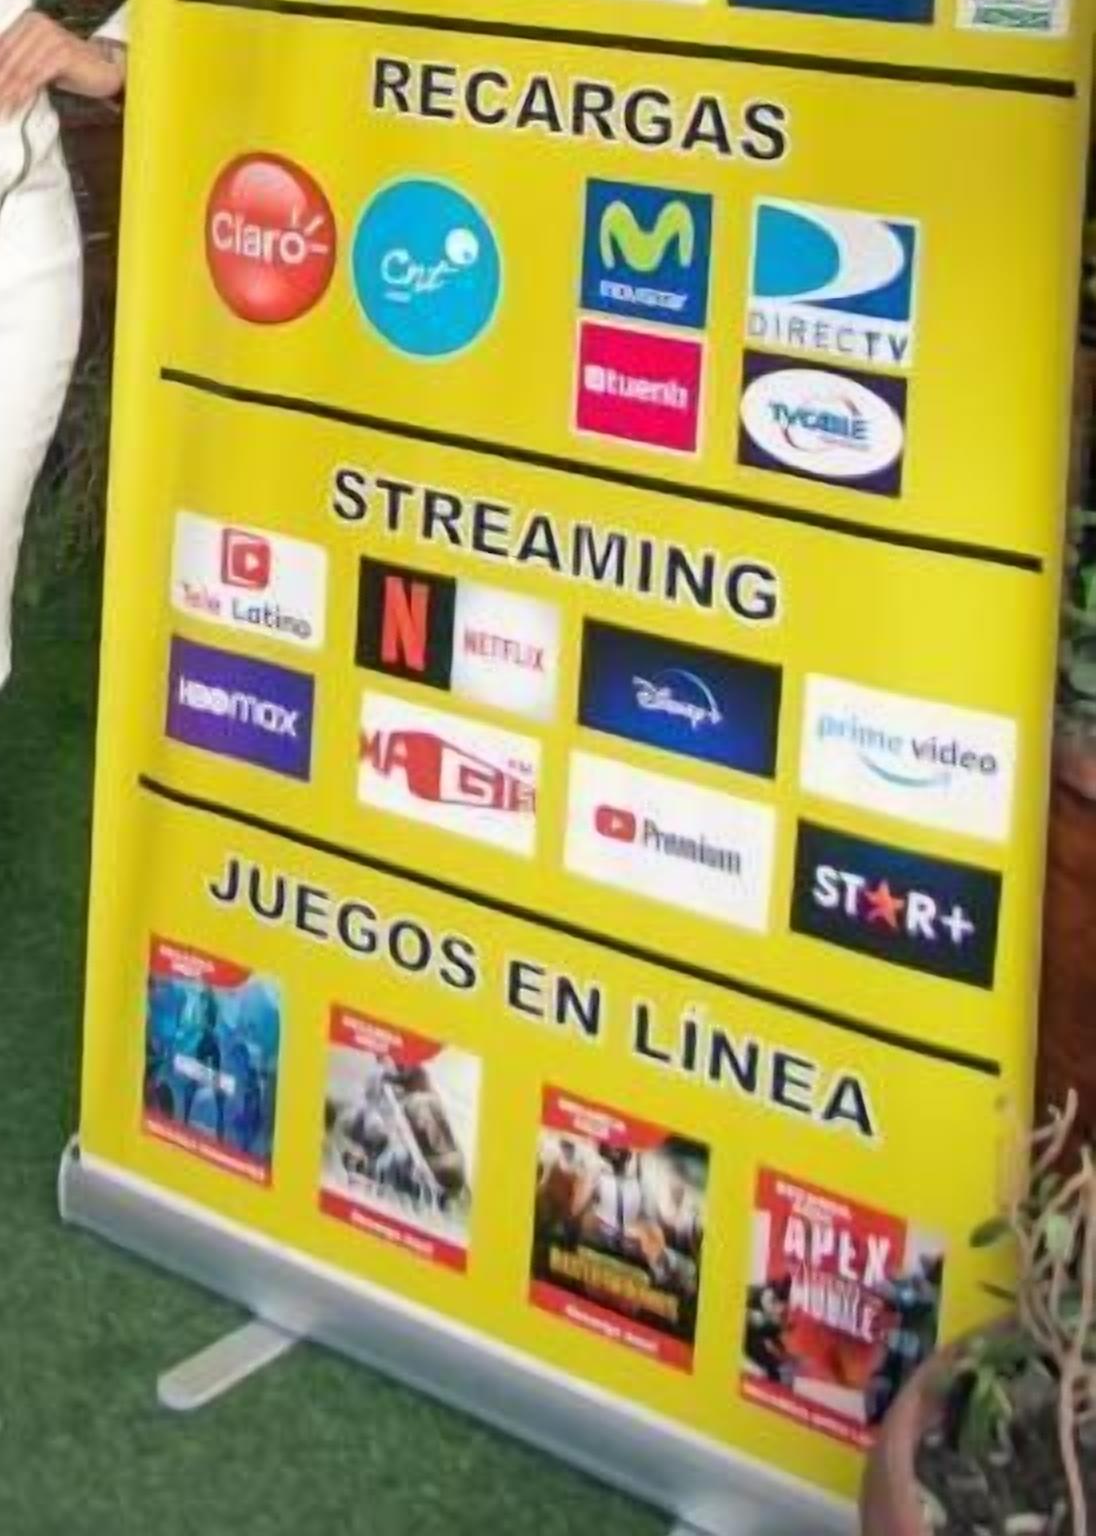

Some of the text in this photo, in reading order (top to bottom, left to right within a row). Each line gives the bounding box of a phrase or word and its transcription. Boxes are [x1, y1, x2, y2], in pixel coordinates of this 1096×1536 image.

[373, 57, 786, 160] RECARGAS
[211, 211, 306, 265] Claro
[748, 309, 908, 362] DIRECTV
[333, 470, 778, 621] STREAMING
[232, 597, 312, 641] Latino
[463, 627, 545, 674] NETFLIX
[817, 710, 998, 776] prime video
[643, 818, 741, 875] Premium
[209, 859, 874, 1137] JUEGOS EN LÍNEA
[784, 1214, 892, 1287] APEX
